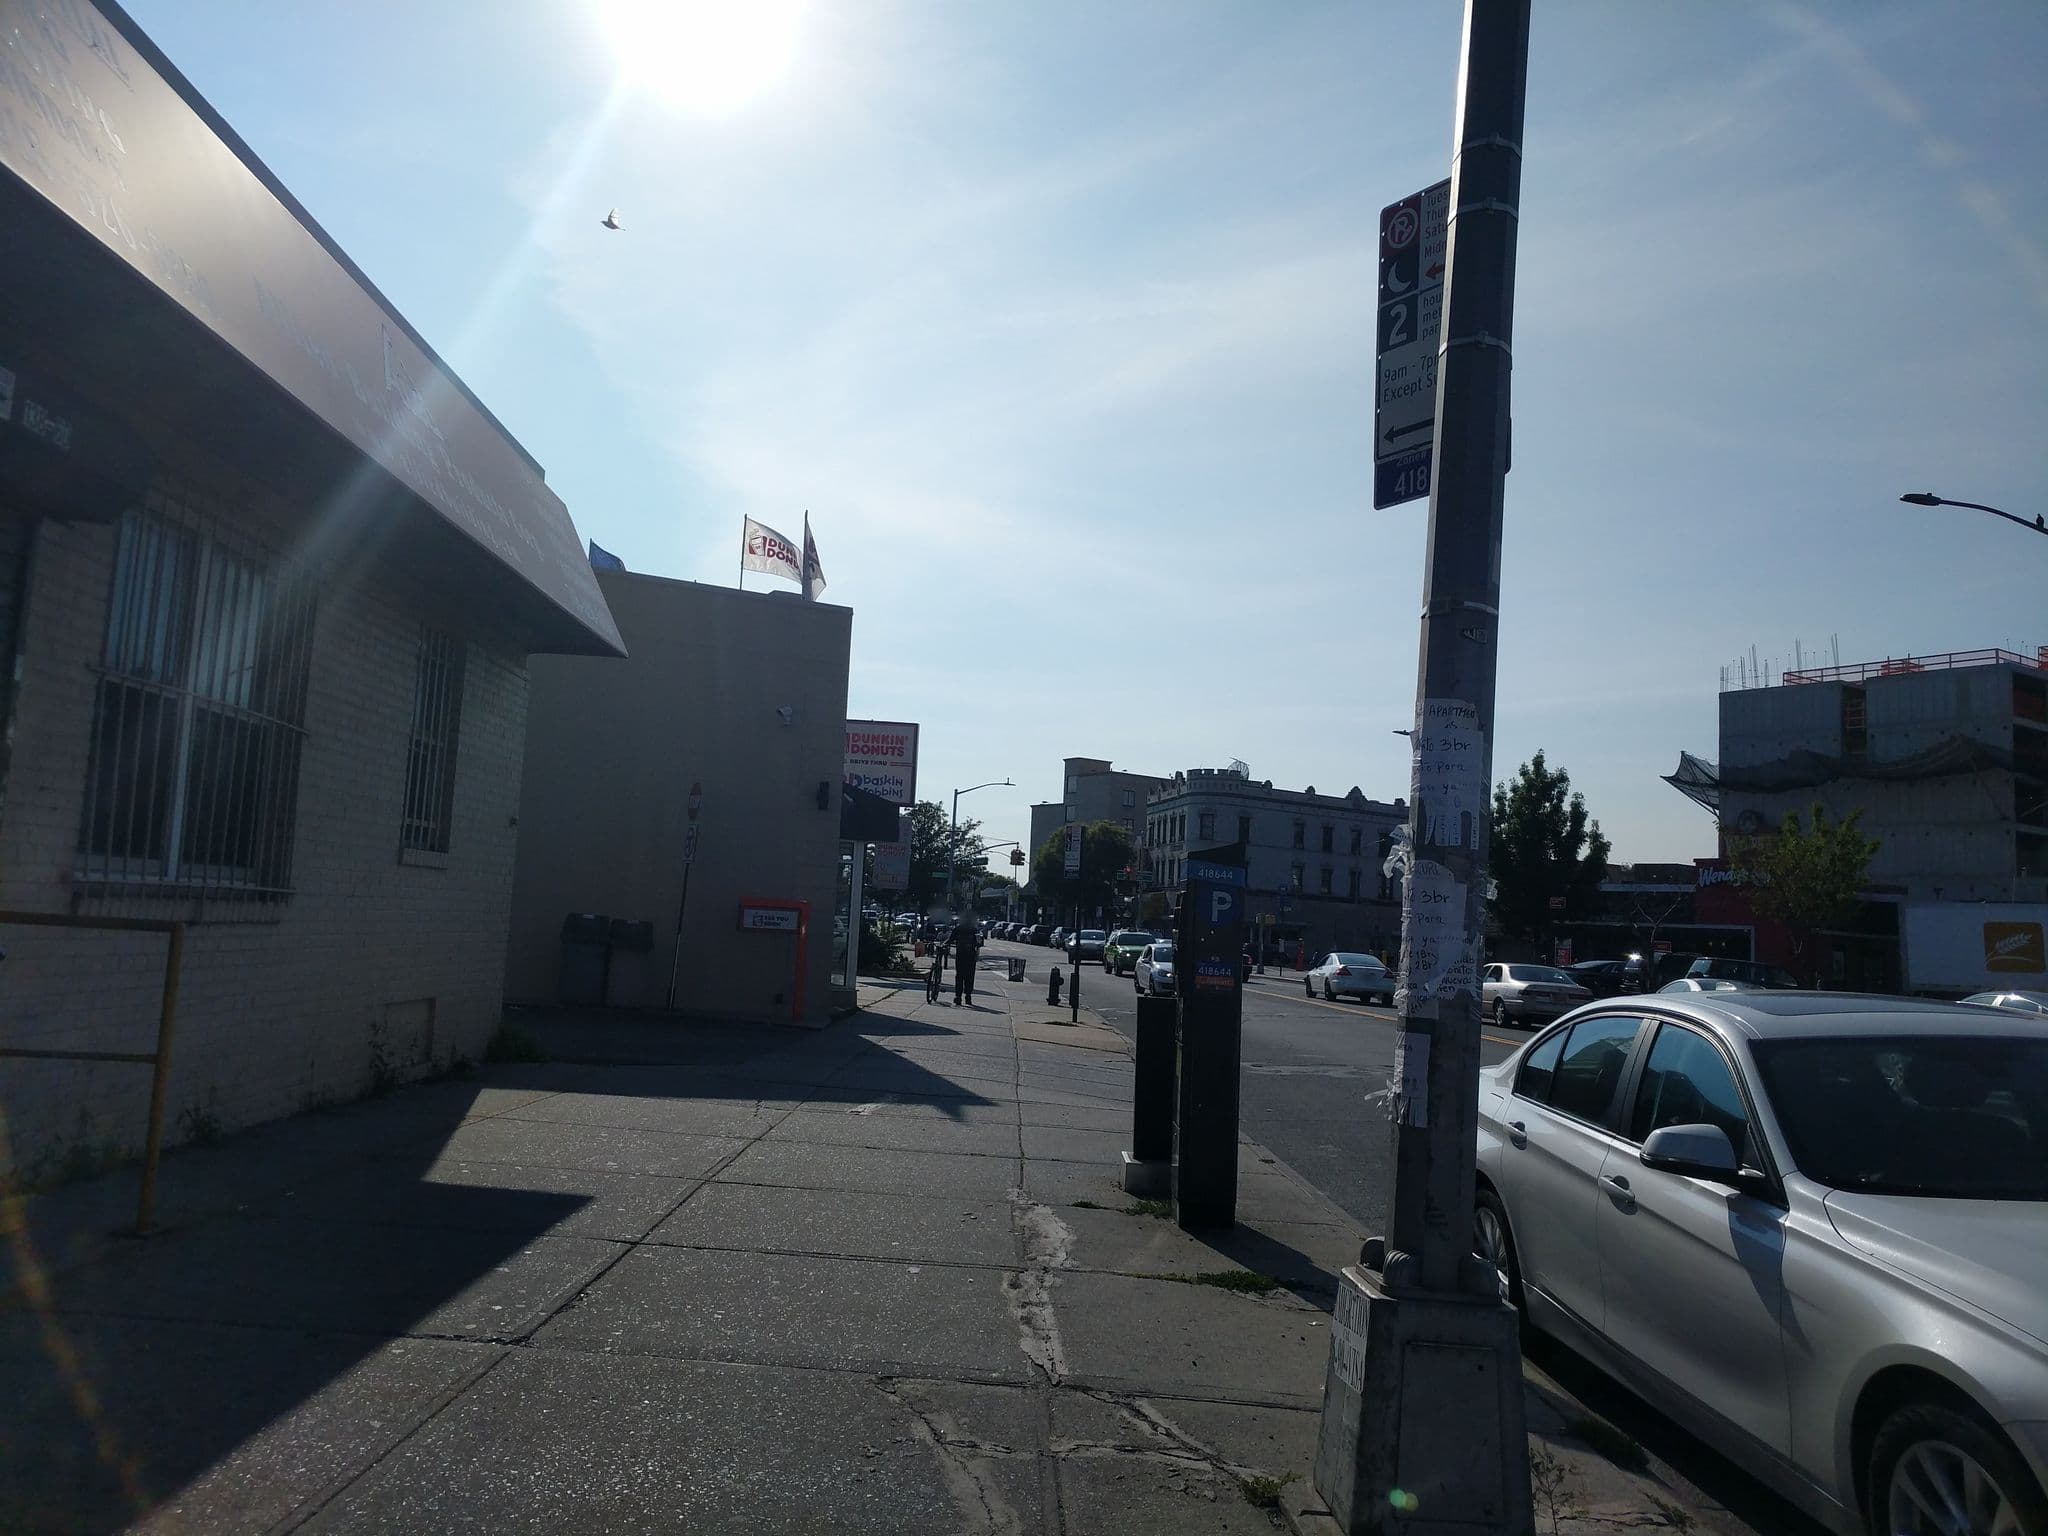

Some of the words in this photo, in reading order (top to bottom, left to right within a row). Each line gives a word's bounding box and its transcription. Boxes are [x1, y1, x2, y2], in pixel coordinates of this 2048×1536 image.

[1389, 303, 1408, 346] 2
[1383, 366, 1408, 385] 9am
[1383, 376, 1423, 404] Except
[850, 743, 905, 758] DONUTS
[1198, 868, 1233, 880] 418644
[1210, 890, 1232, 923] P
[1198, 967, 1233, 977] 418644
